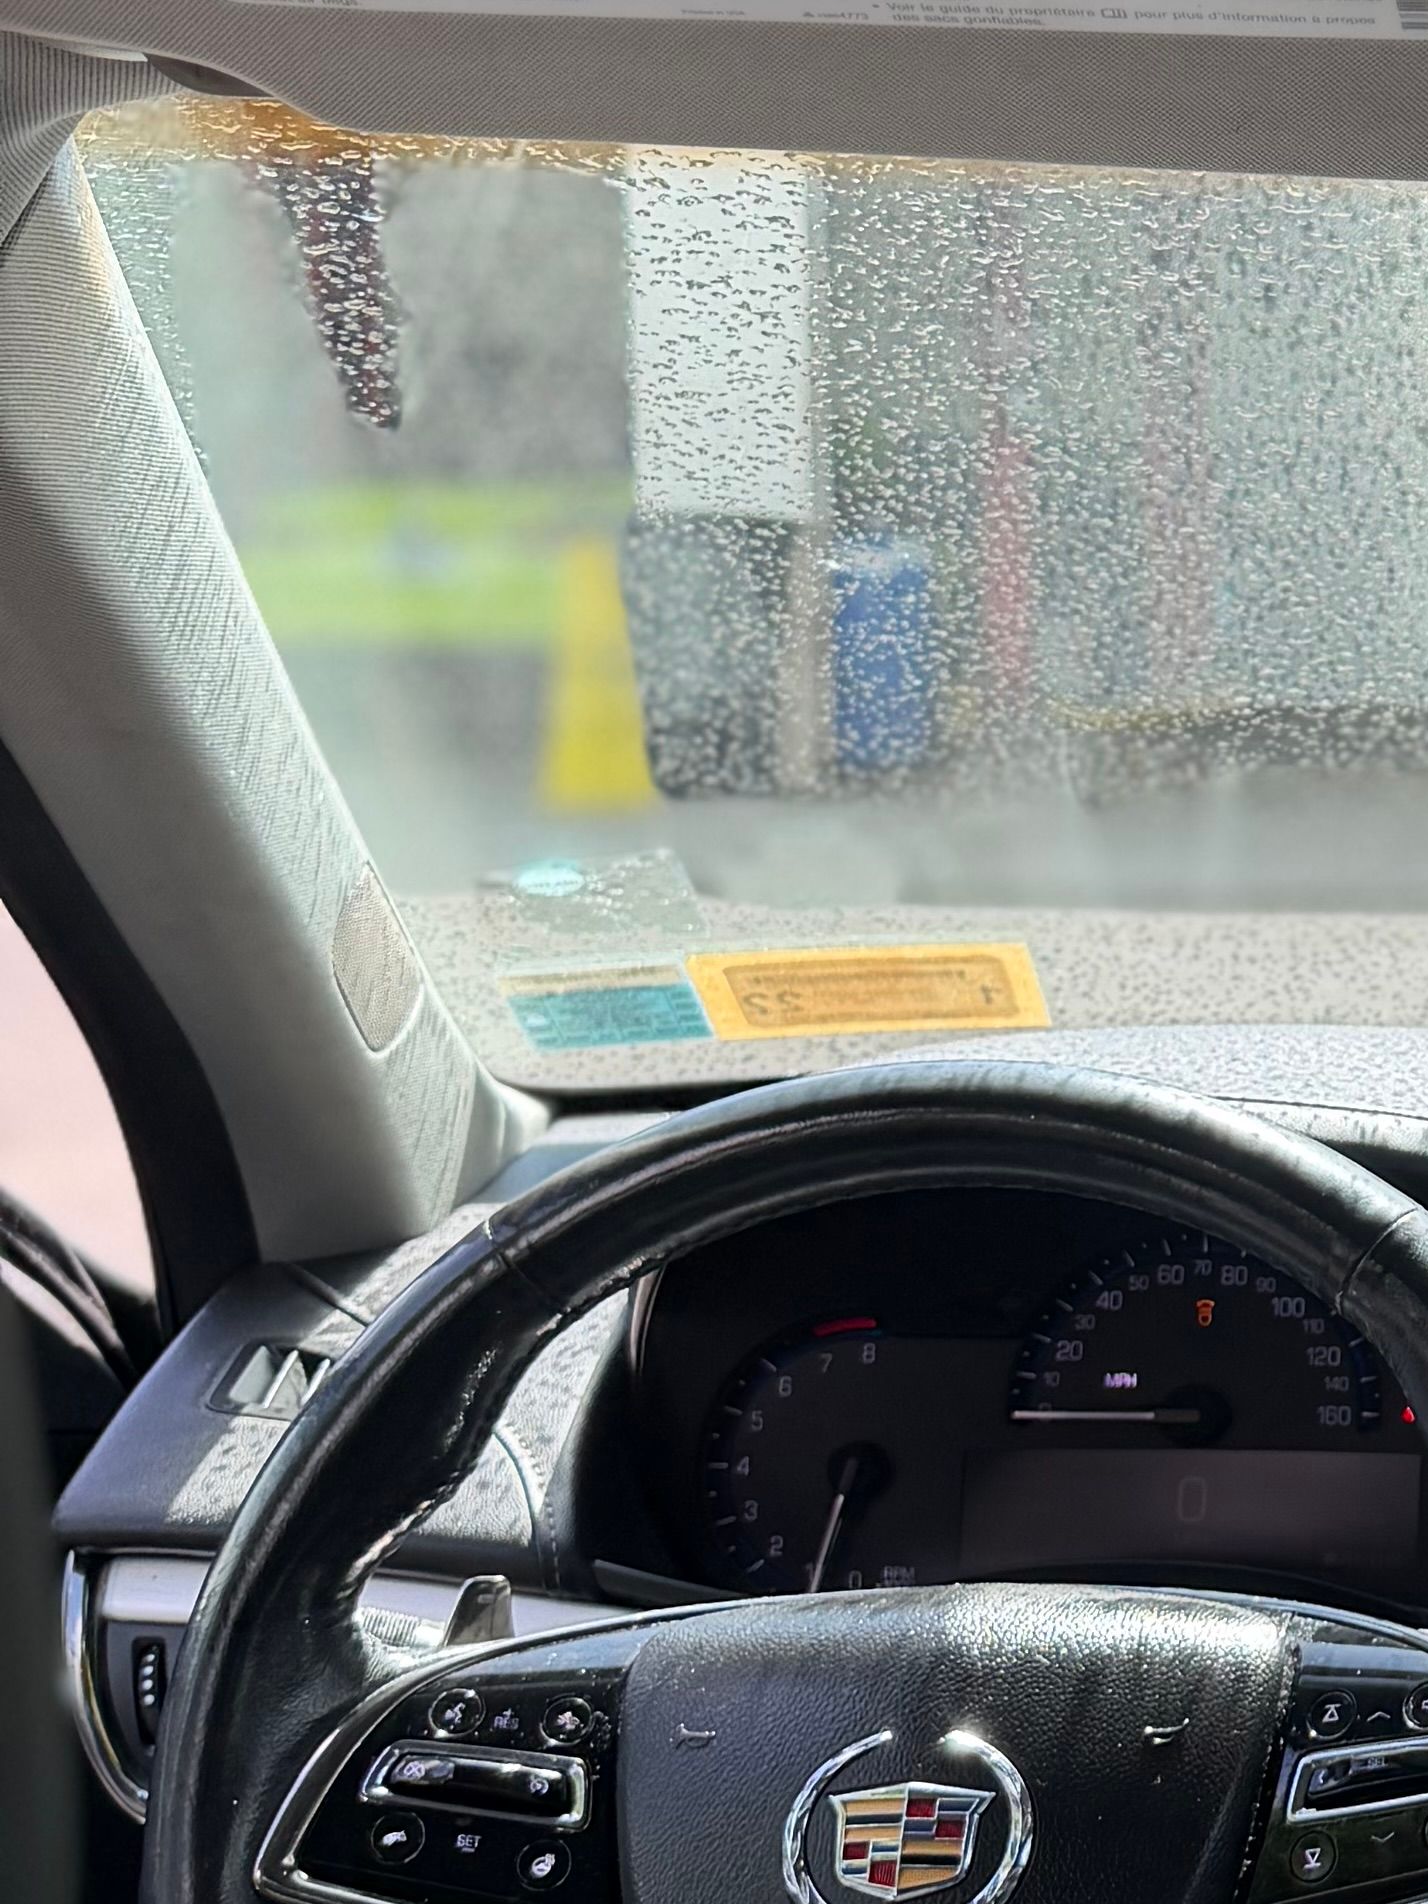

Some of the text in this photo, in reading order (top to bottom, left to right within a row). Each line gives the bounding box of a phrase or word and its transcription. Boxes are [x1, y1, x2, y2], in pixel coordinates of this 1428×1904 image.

[1157, 1265, 1184, 1285] 60
[1194, 1260, 1212, 1275] 70
[1221, 1266, 1248, 1286] 80
[1129, 1274, 1149, 1291] 50
[1256, 1276, 1276, 1293] 90
[1096, 1291, 1123, 1310] 40
[1272, 1297, 1305, 1318] 100
[1075, 1314, 1095, 1330] 30
[862, 1344, 876, 1364] 8
[1056, 1340, 1083, 1360] 20
[1307, 1347, 1341, 1366] 120
[820, 1352, 833, 1373] 7
[778, 1376, 792, 1396] 6
[1042, 1372, 1059, 1387] 10
[1325, 1376, 1348, 1392] 140
[751, 1411, 763, 1431] 5
[1317, 1405, 1351, 1426] 160
[737, 1456, 750, 1475] 4
[744, 1501, 758, 1520] 3
[770, 1536, 783, 1555] 2
[456, 1834, 481, 1846] SET
